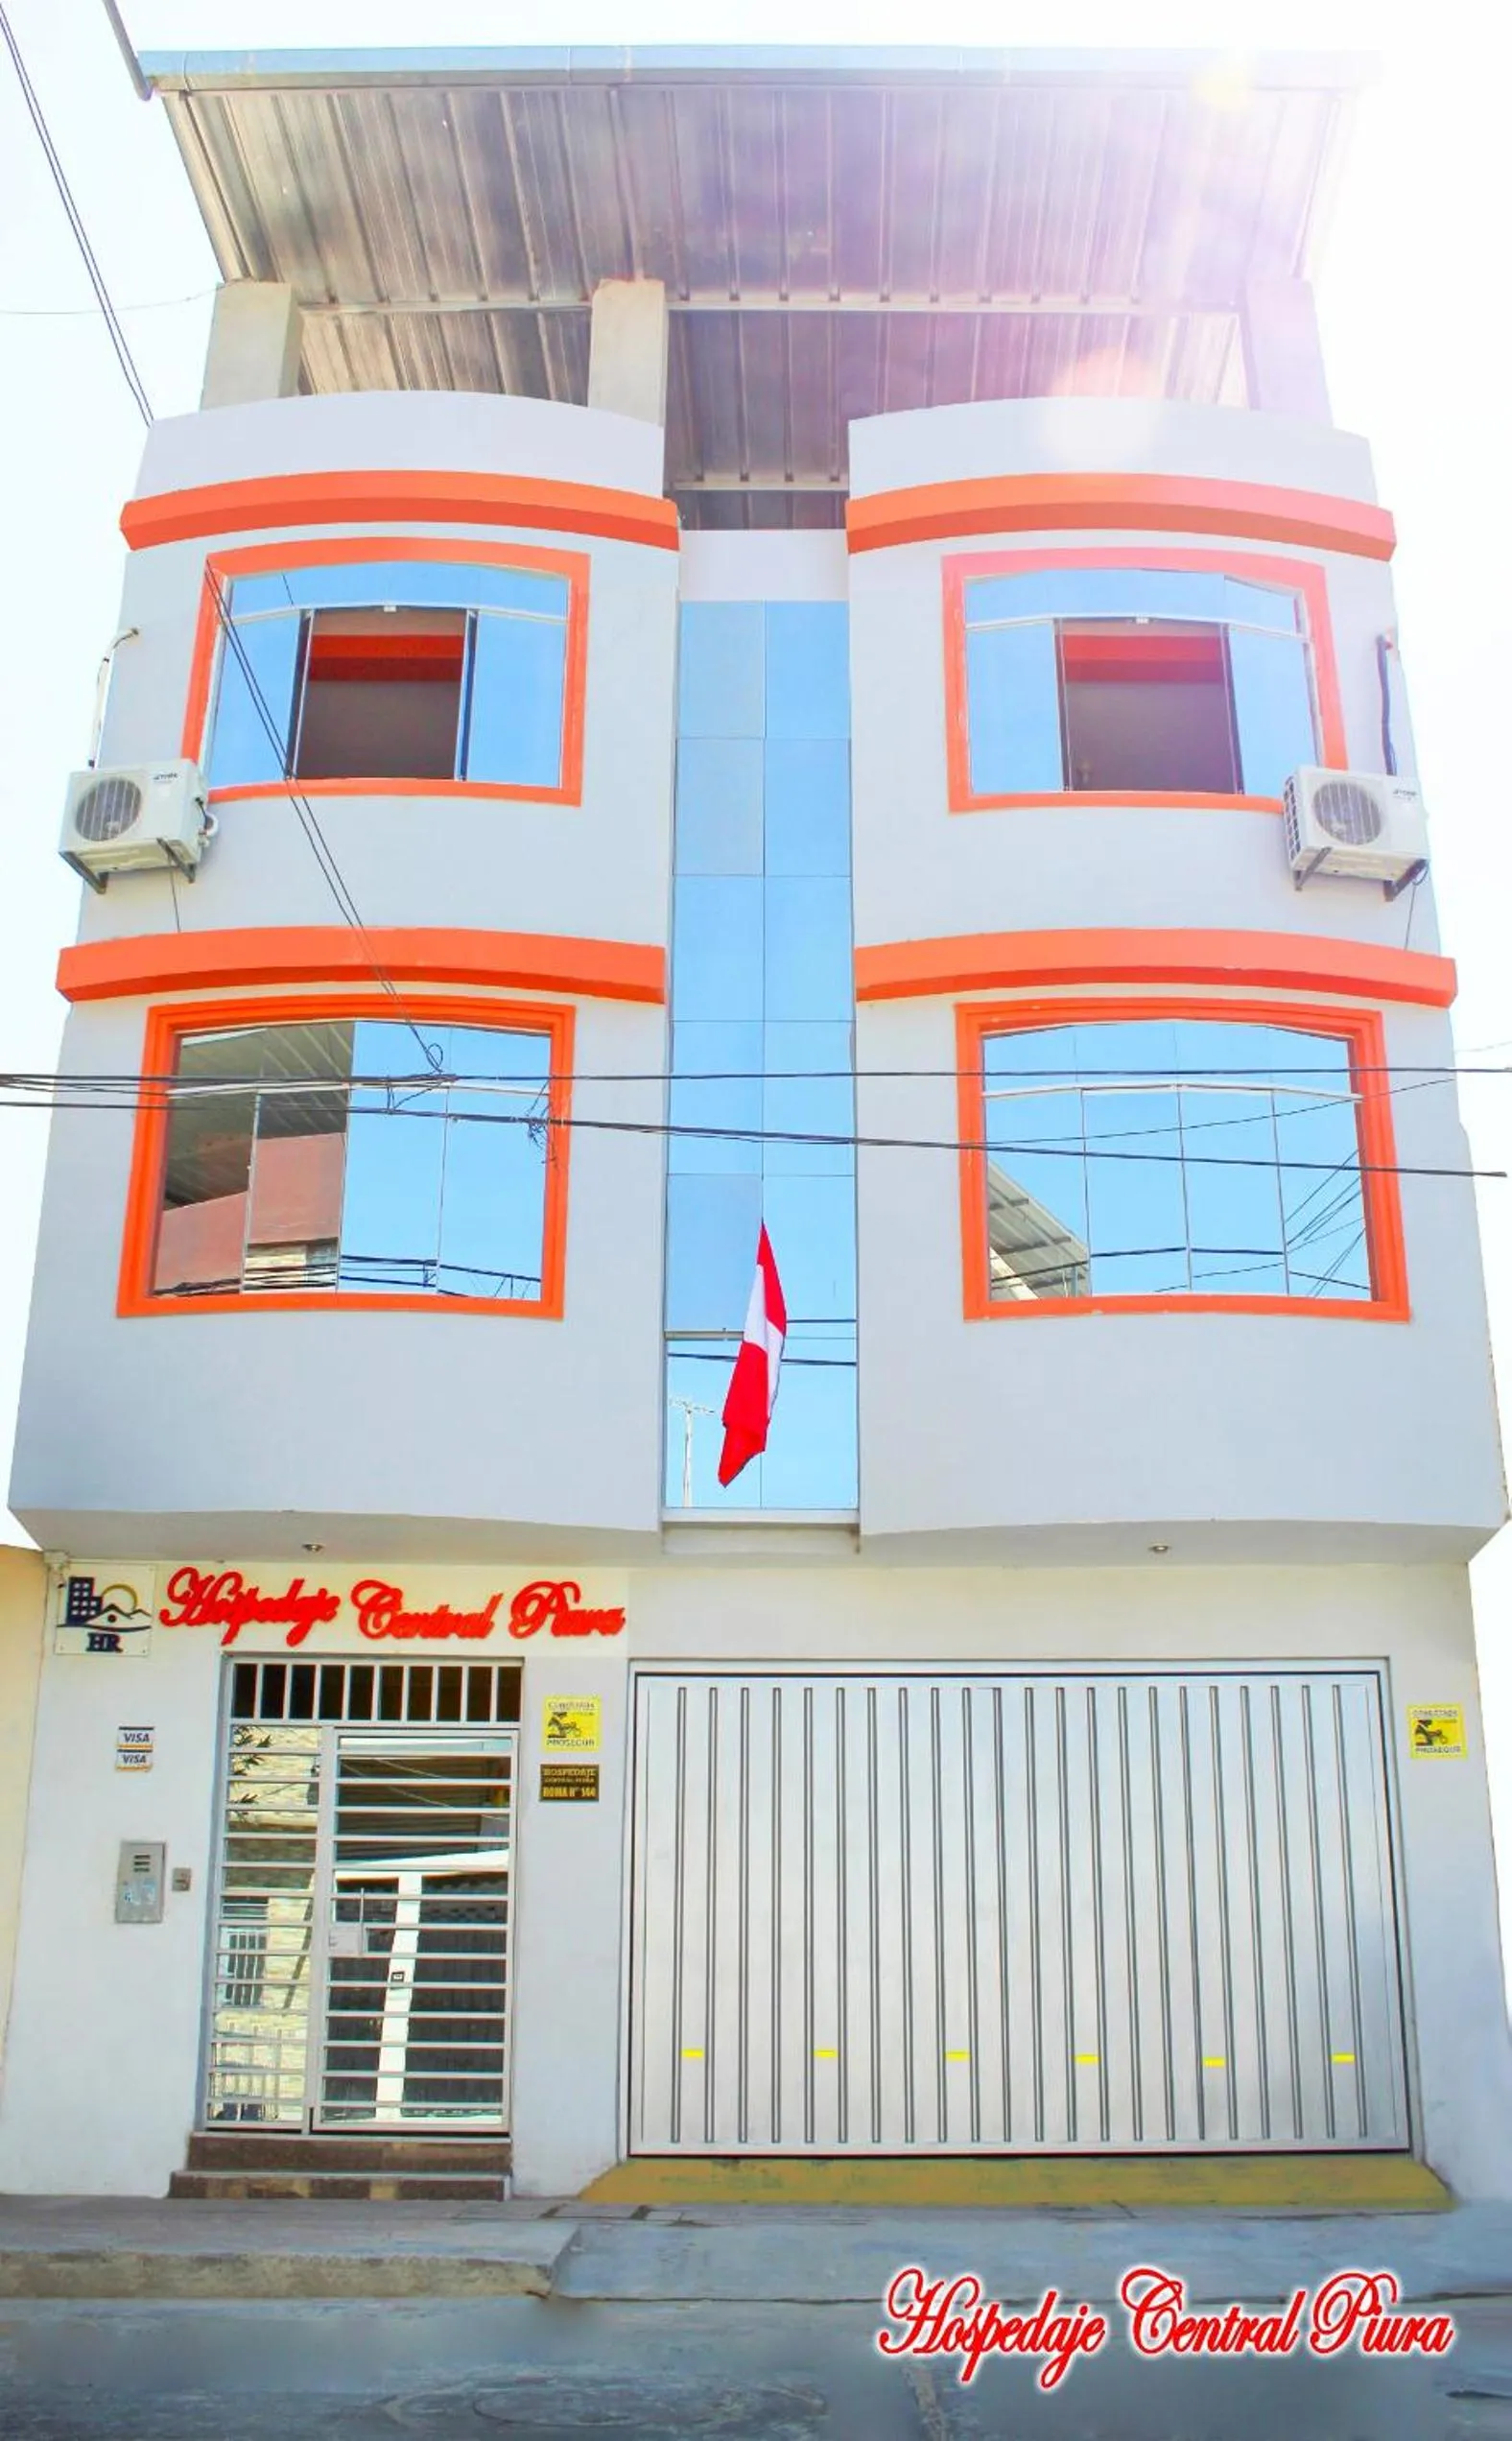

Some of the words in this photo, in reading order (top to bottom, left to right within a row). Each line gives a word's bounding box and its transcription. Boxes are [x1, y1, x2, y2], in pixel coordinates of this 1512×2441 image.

[158, 1566, 341, 1647] Hospedaje
[350, 1578, 505, 1640] Central
[508, 1580, 626, 1639] Piura
[124, 1732, 150, 1742] VISA
[123, 1753, 147, 1765] VISA
